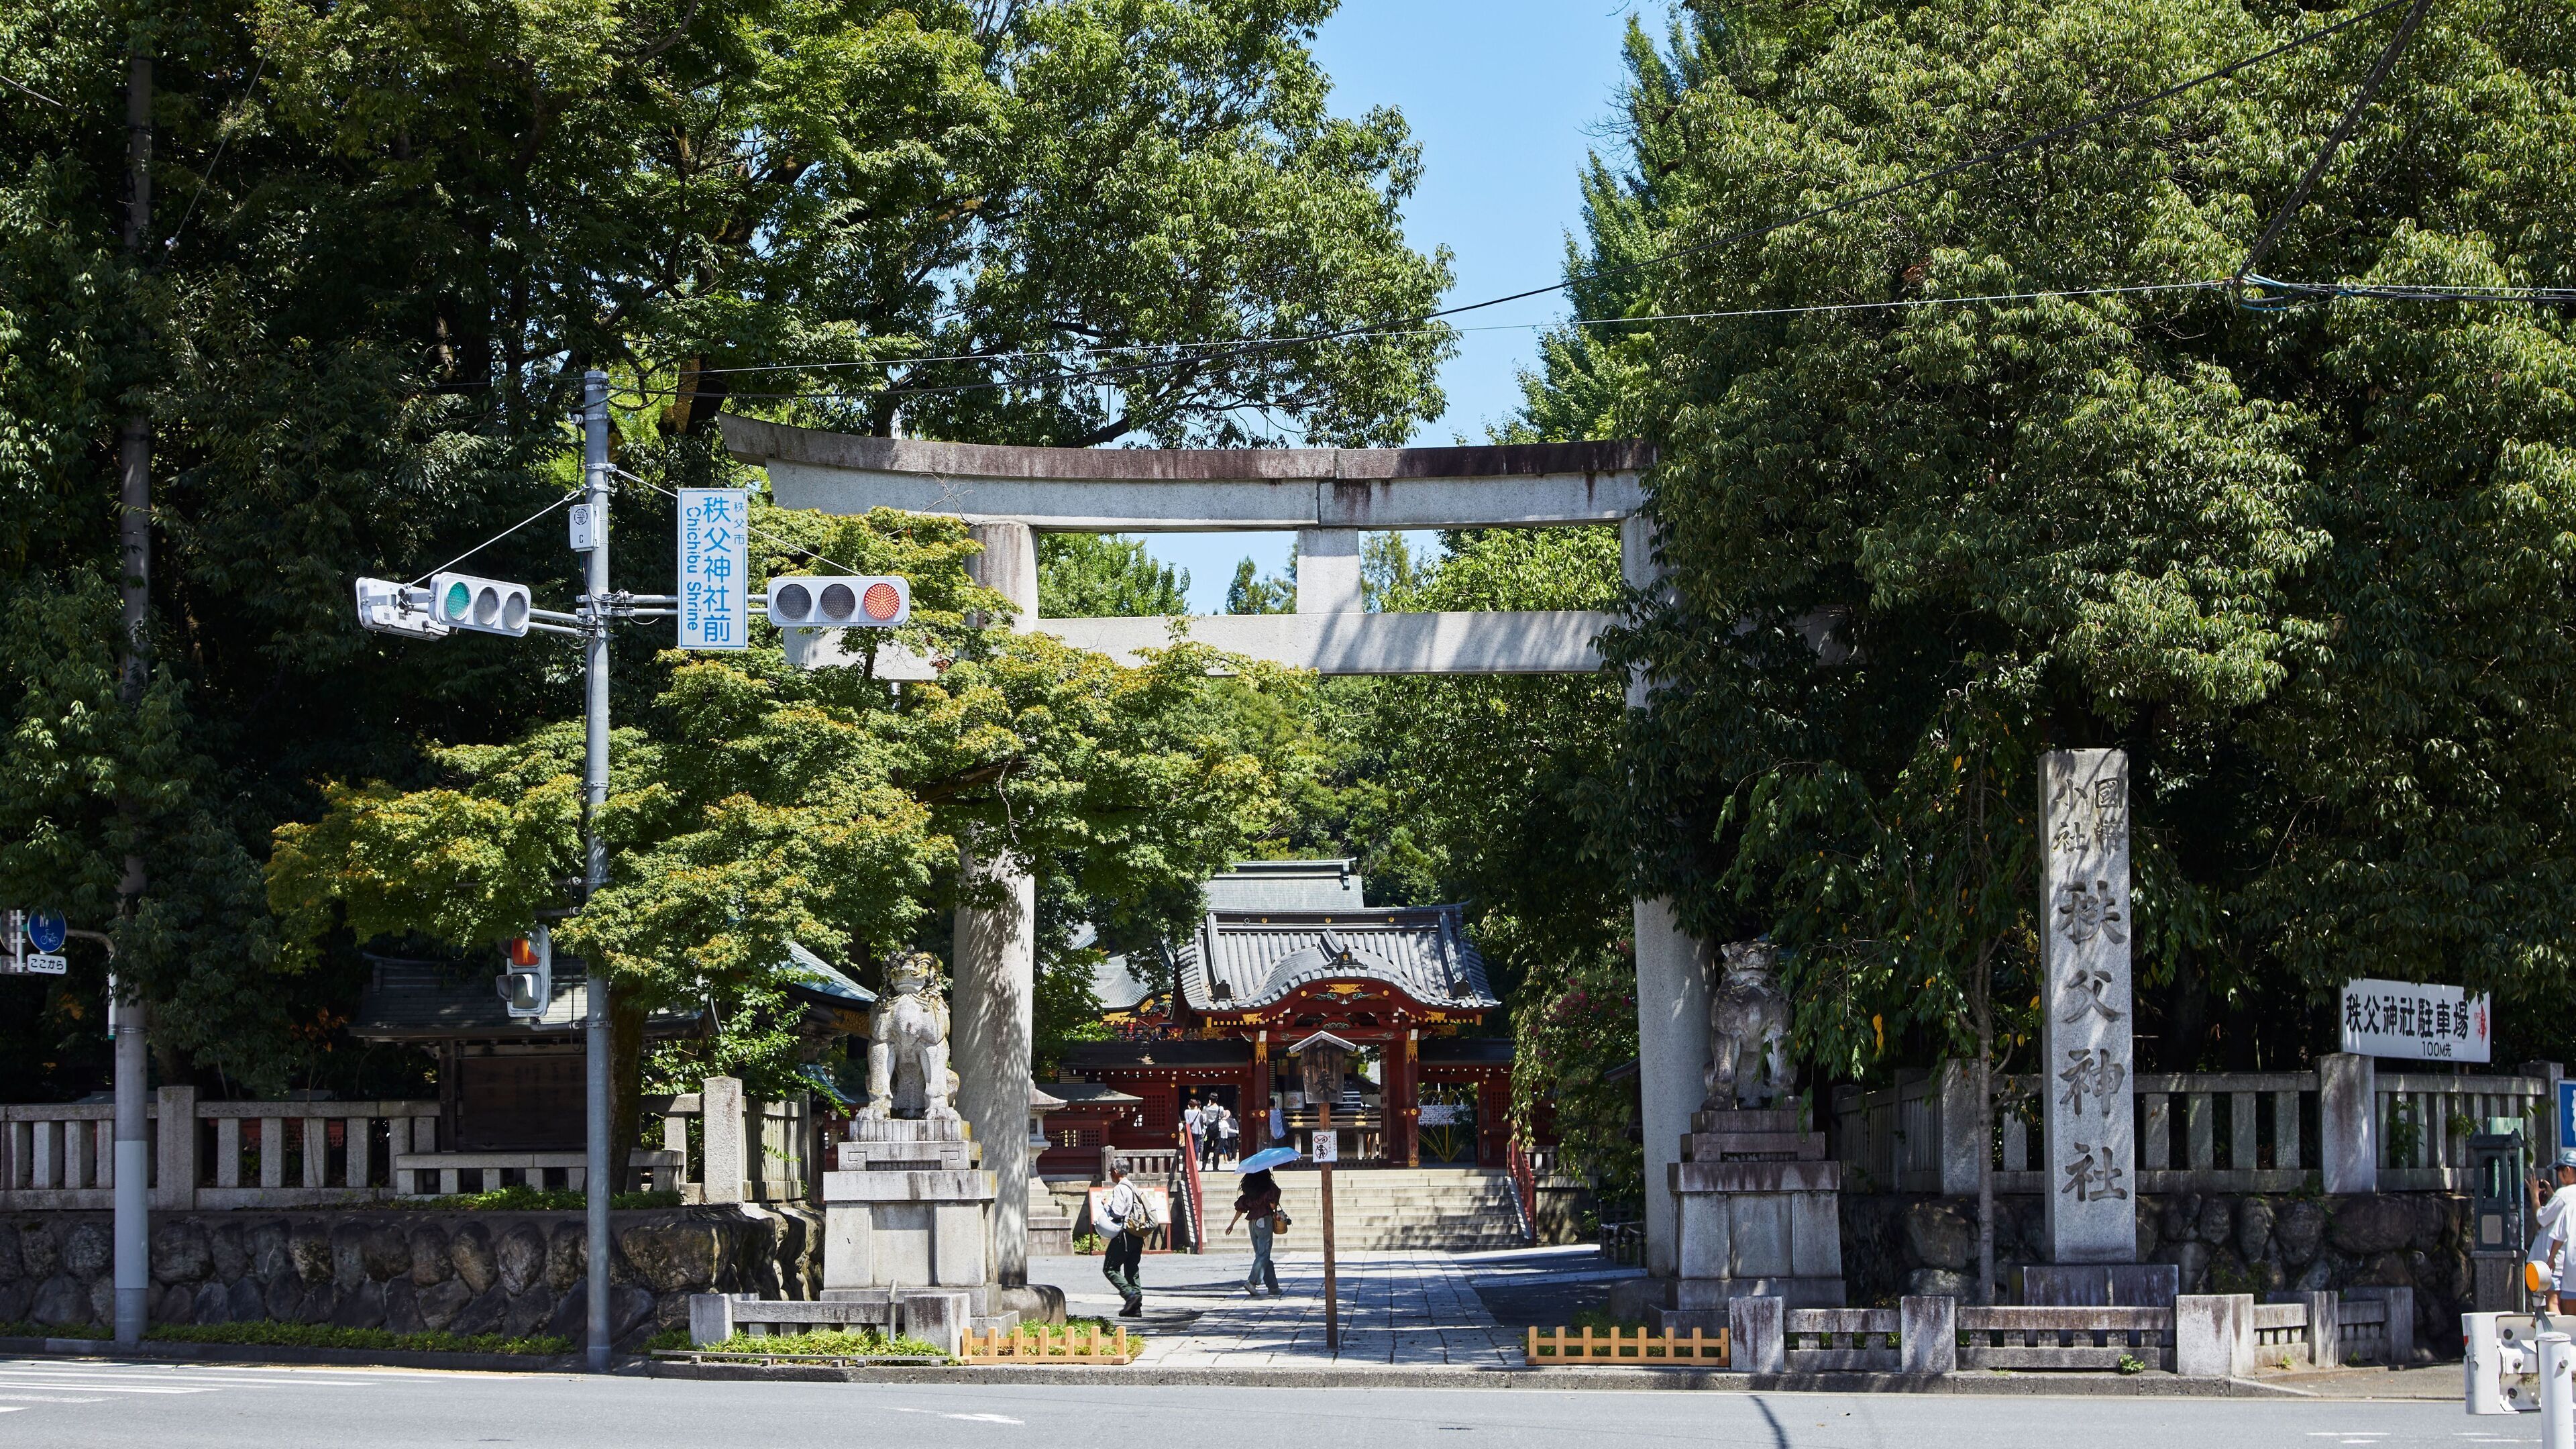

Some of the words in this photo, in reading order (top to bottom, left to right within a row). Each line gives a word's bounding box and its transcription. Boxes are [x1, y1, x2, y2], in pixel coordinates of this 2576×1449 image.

[579, 534, 584, 543] C
[686, 506, 701, 574] Chichibu
[734, 502, 745, 545] 秩父市
[703, 496, 731, 642] 秩父神社前
[686, 582, 702, 631] Shrine
[2052, 777, 2090, 854] 小社
[31, 958, 64, 970] ここから
[2058, 879, 2128, 1202] 秩父神社
[2346, 993, 2469, 1040] 秩父神社駐車場
[2422, 1041, 2452, 1057] 100M先
